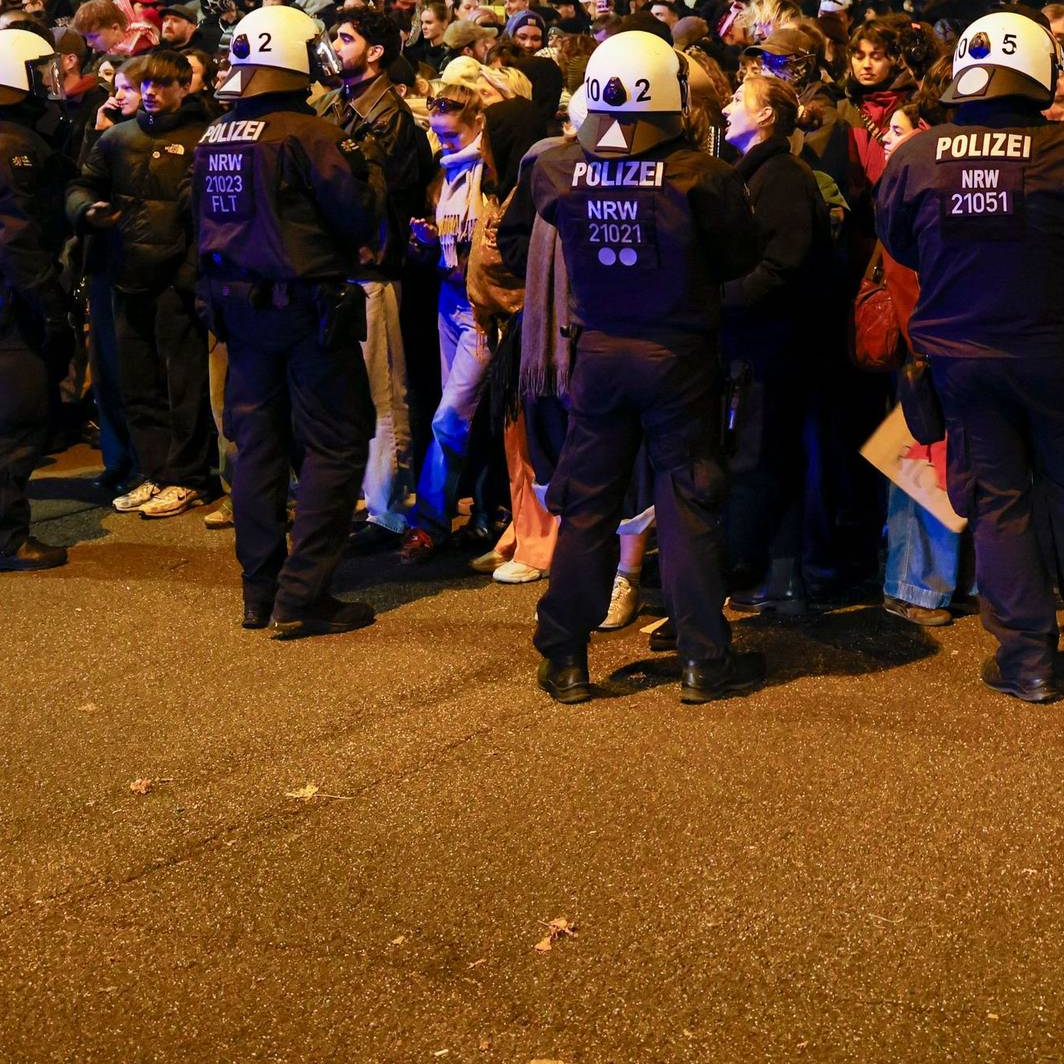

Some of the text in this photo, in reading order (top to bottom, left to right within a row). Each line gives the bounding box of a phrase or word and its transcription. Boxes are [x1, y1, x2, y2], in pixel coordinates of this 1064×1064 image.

[258, 33, 272, 52] 2
[1002, 34, 1017, 55] 5
[586, 76, 651, 102] 10 2
[199, 120, 266, 144] POLIZEI
[935, 133, 1032, 161] POLIZEI
[209, 154, 243, 172] NRW
[206, 175, 243, 193] 21023
[571, 161, 664, 187] POLIZEI
[961, 169, 1000, 189] NRW
[211, 195, 237, 213] FLT
[587, 200, 638, 221] NRW
[951, 191, 1008, 215] 21051
[588, 223, 642, 244] 21021
